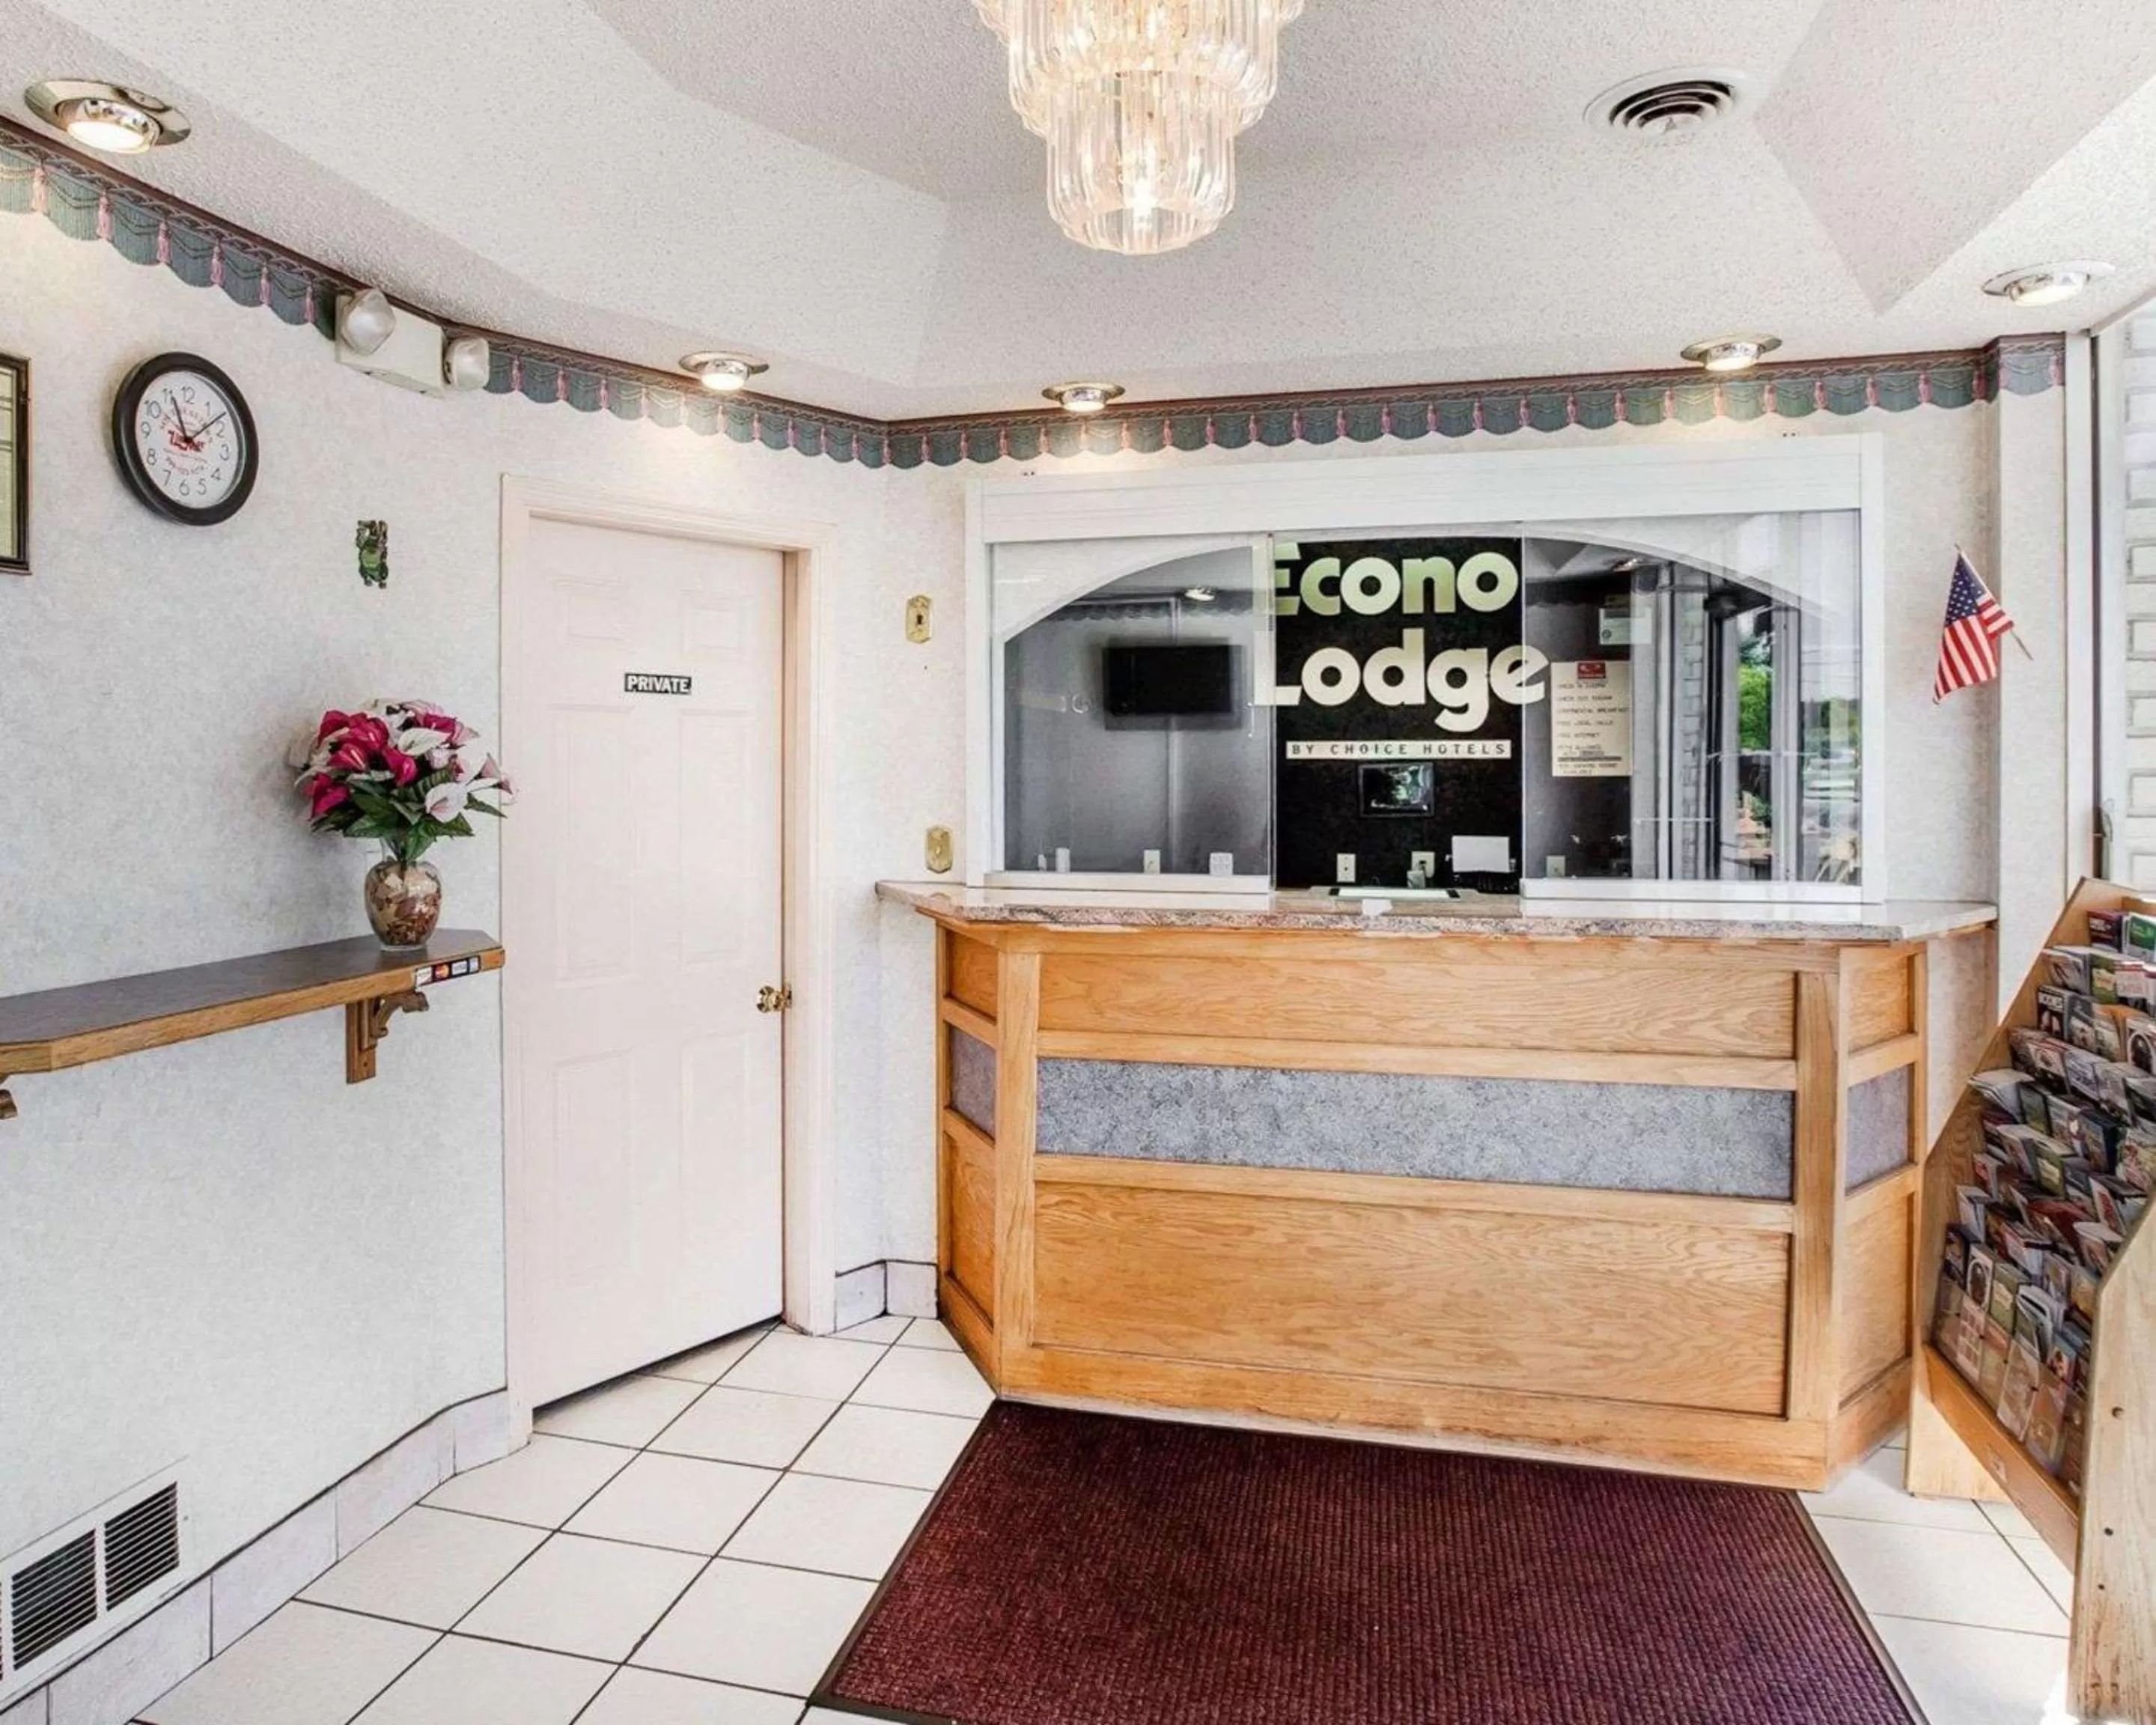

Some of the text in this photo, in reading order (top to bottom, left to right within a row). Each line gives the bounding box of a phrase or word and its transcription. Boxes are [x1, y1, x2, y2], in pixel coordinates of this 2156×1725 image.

[181, 386, 196, 404] 12
[144, 400, 162, 419] 10
[205, 401, 211, 416] 1
[140, 421, 151, 438] 9
[216, 420, 226, 438] 2
[146, 448, 157, 466] 8
[219, 443, 230, 461] 3
[162, 469, 171, 486] 7
[210, 467, 222, 481] 4
[179, 479, 190, 496] 6
[197, 478, 207, 496] 5
[1253, 541, 1519, 616] Econo
[627, 675, 689, 693] PRIVATE
[1254, 627, 1550, 733] Lodge
[1291, 743, 1506, 755] BY CHOICE HOTELS
